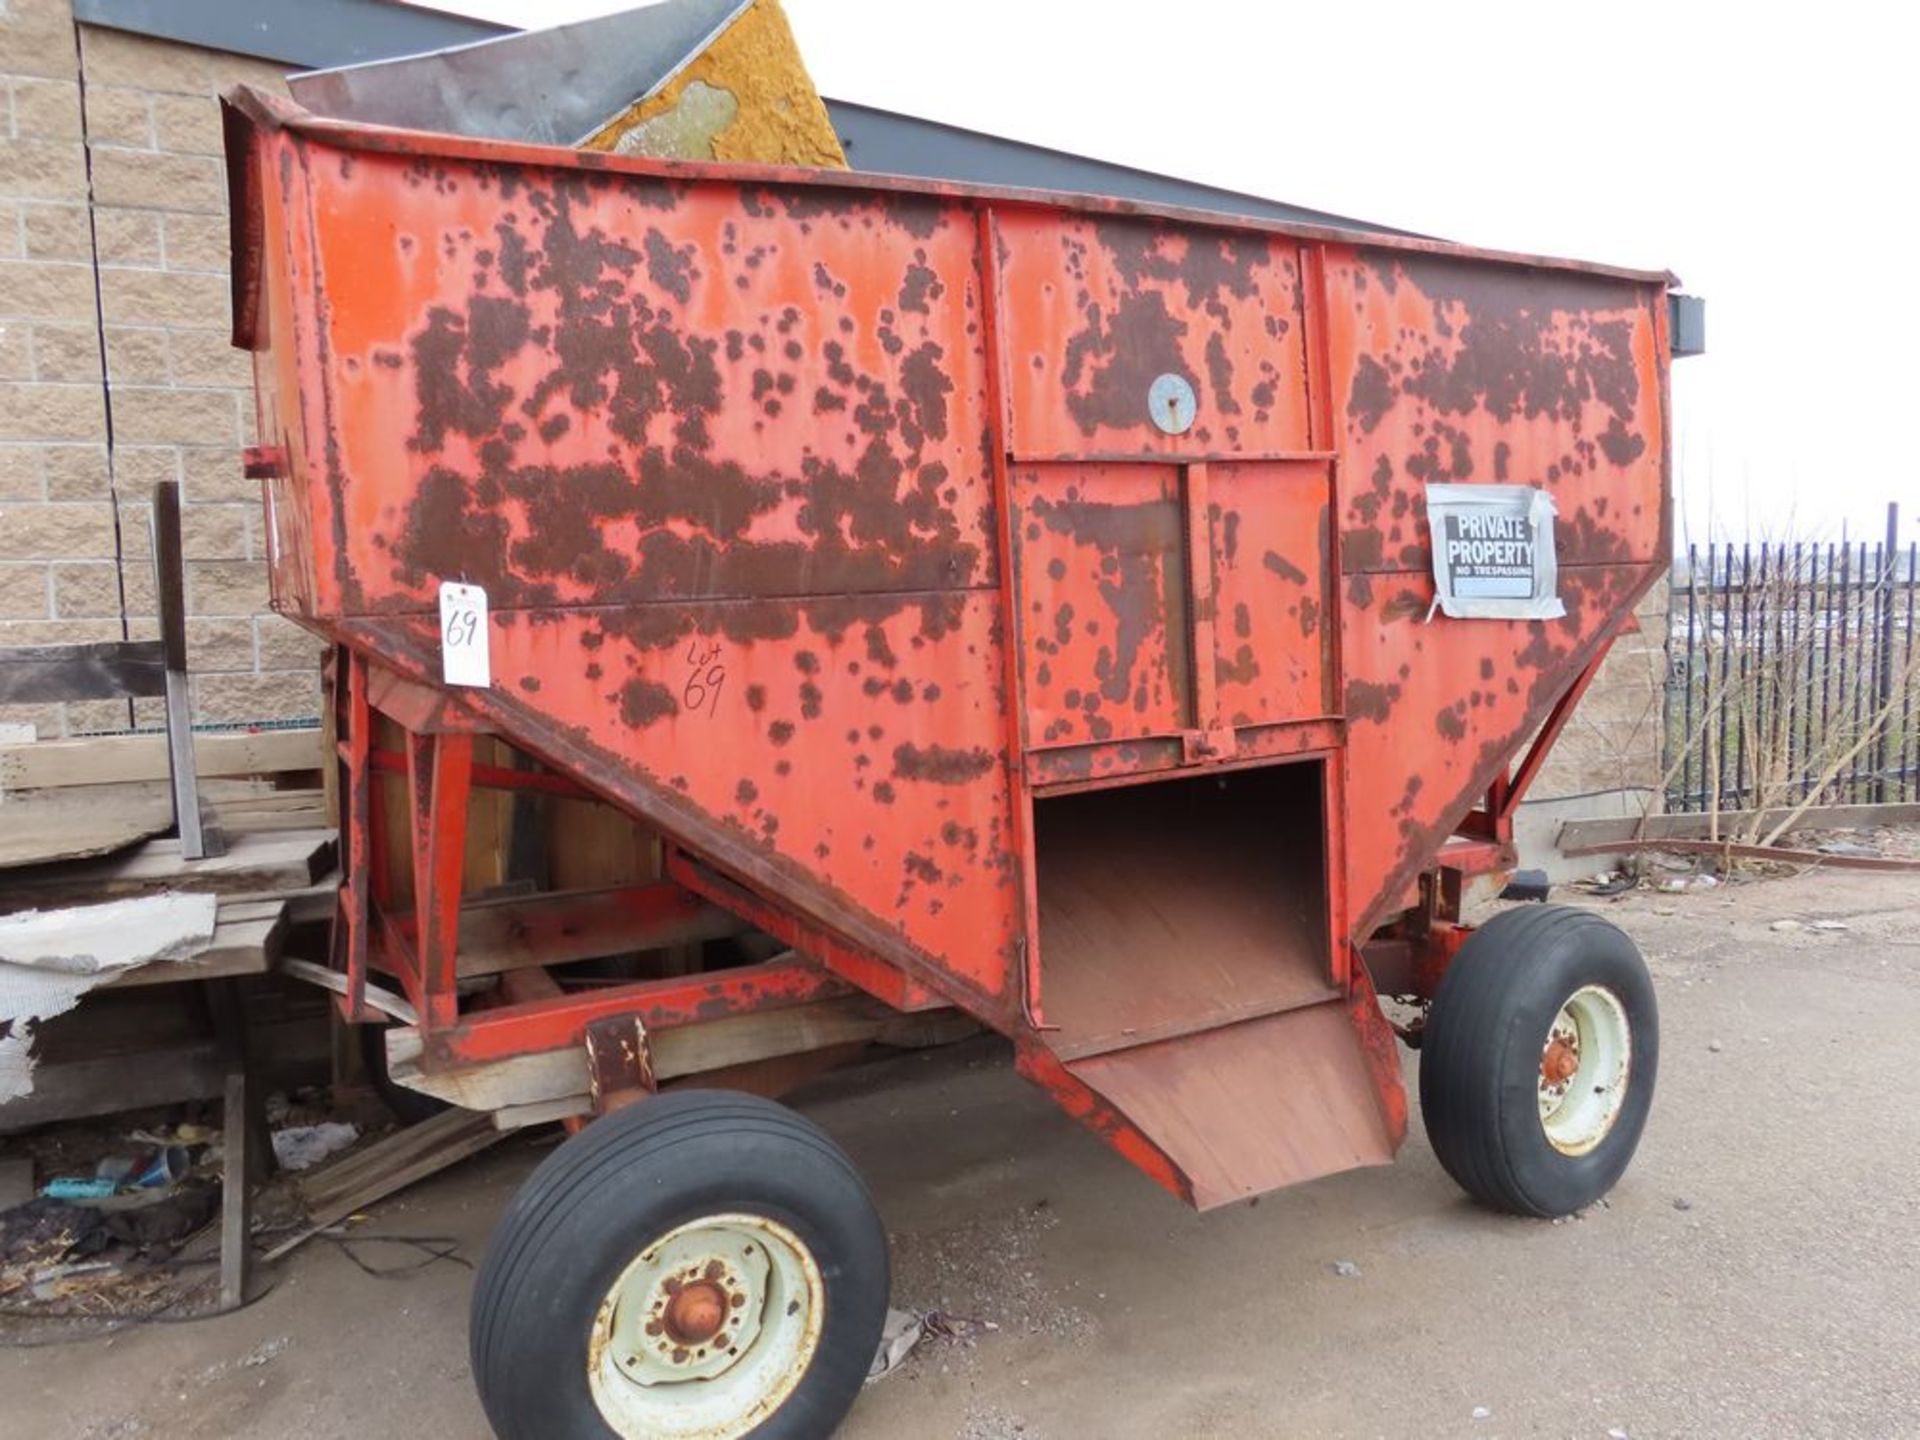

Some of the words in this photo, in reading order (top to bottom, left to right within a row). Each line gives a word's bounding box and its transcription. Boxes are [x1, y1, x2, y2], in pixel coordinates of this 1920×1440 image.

[1458, 515, 1525, 539] PRIVATE
[1449, 540, 1533, 565] PROPERTY
[1456, 565, 1471, 575] NO
[1474, 565, 1533, 576] TRESPASSING
[446, 610, 477, 647] 69
[687, 641, 722, 666] Lot
[684, 665, 725, 719] 69
